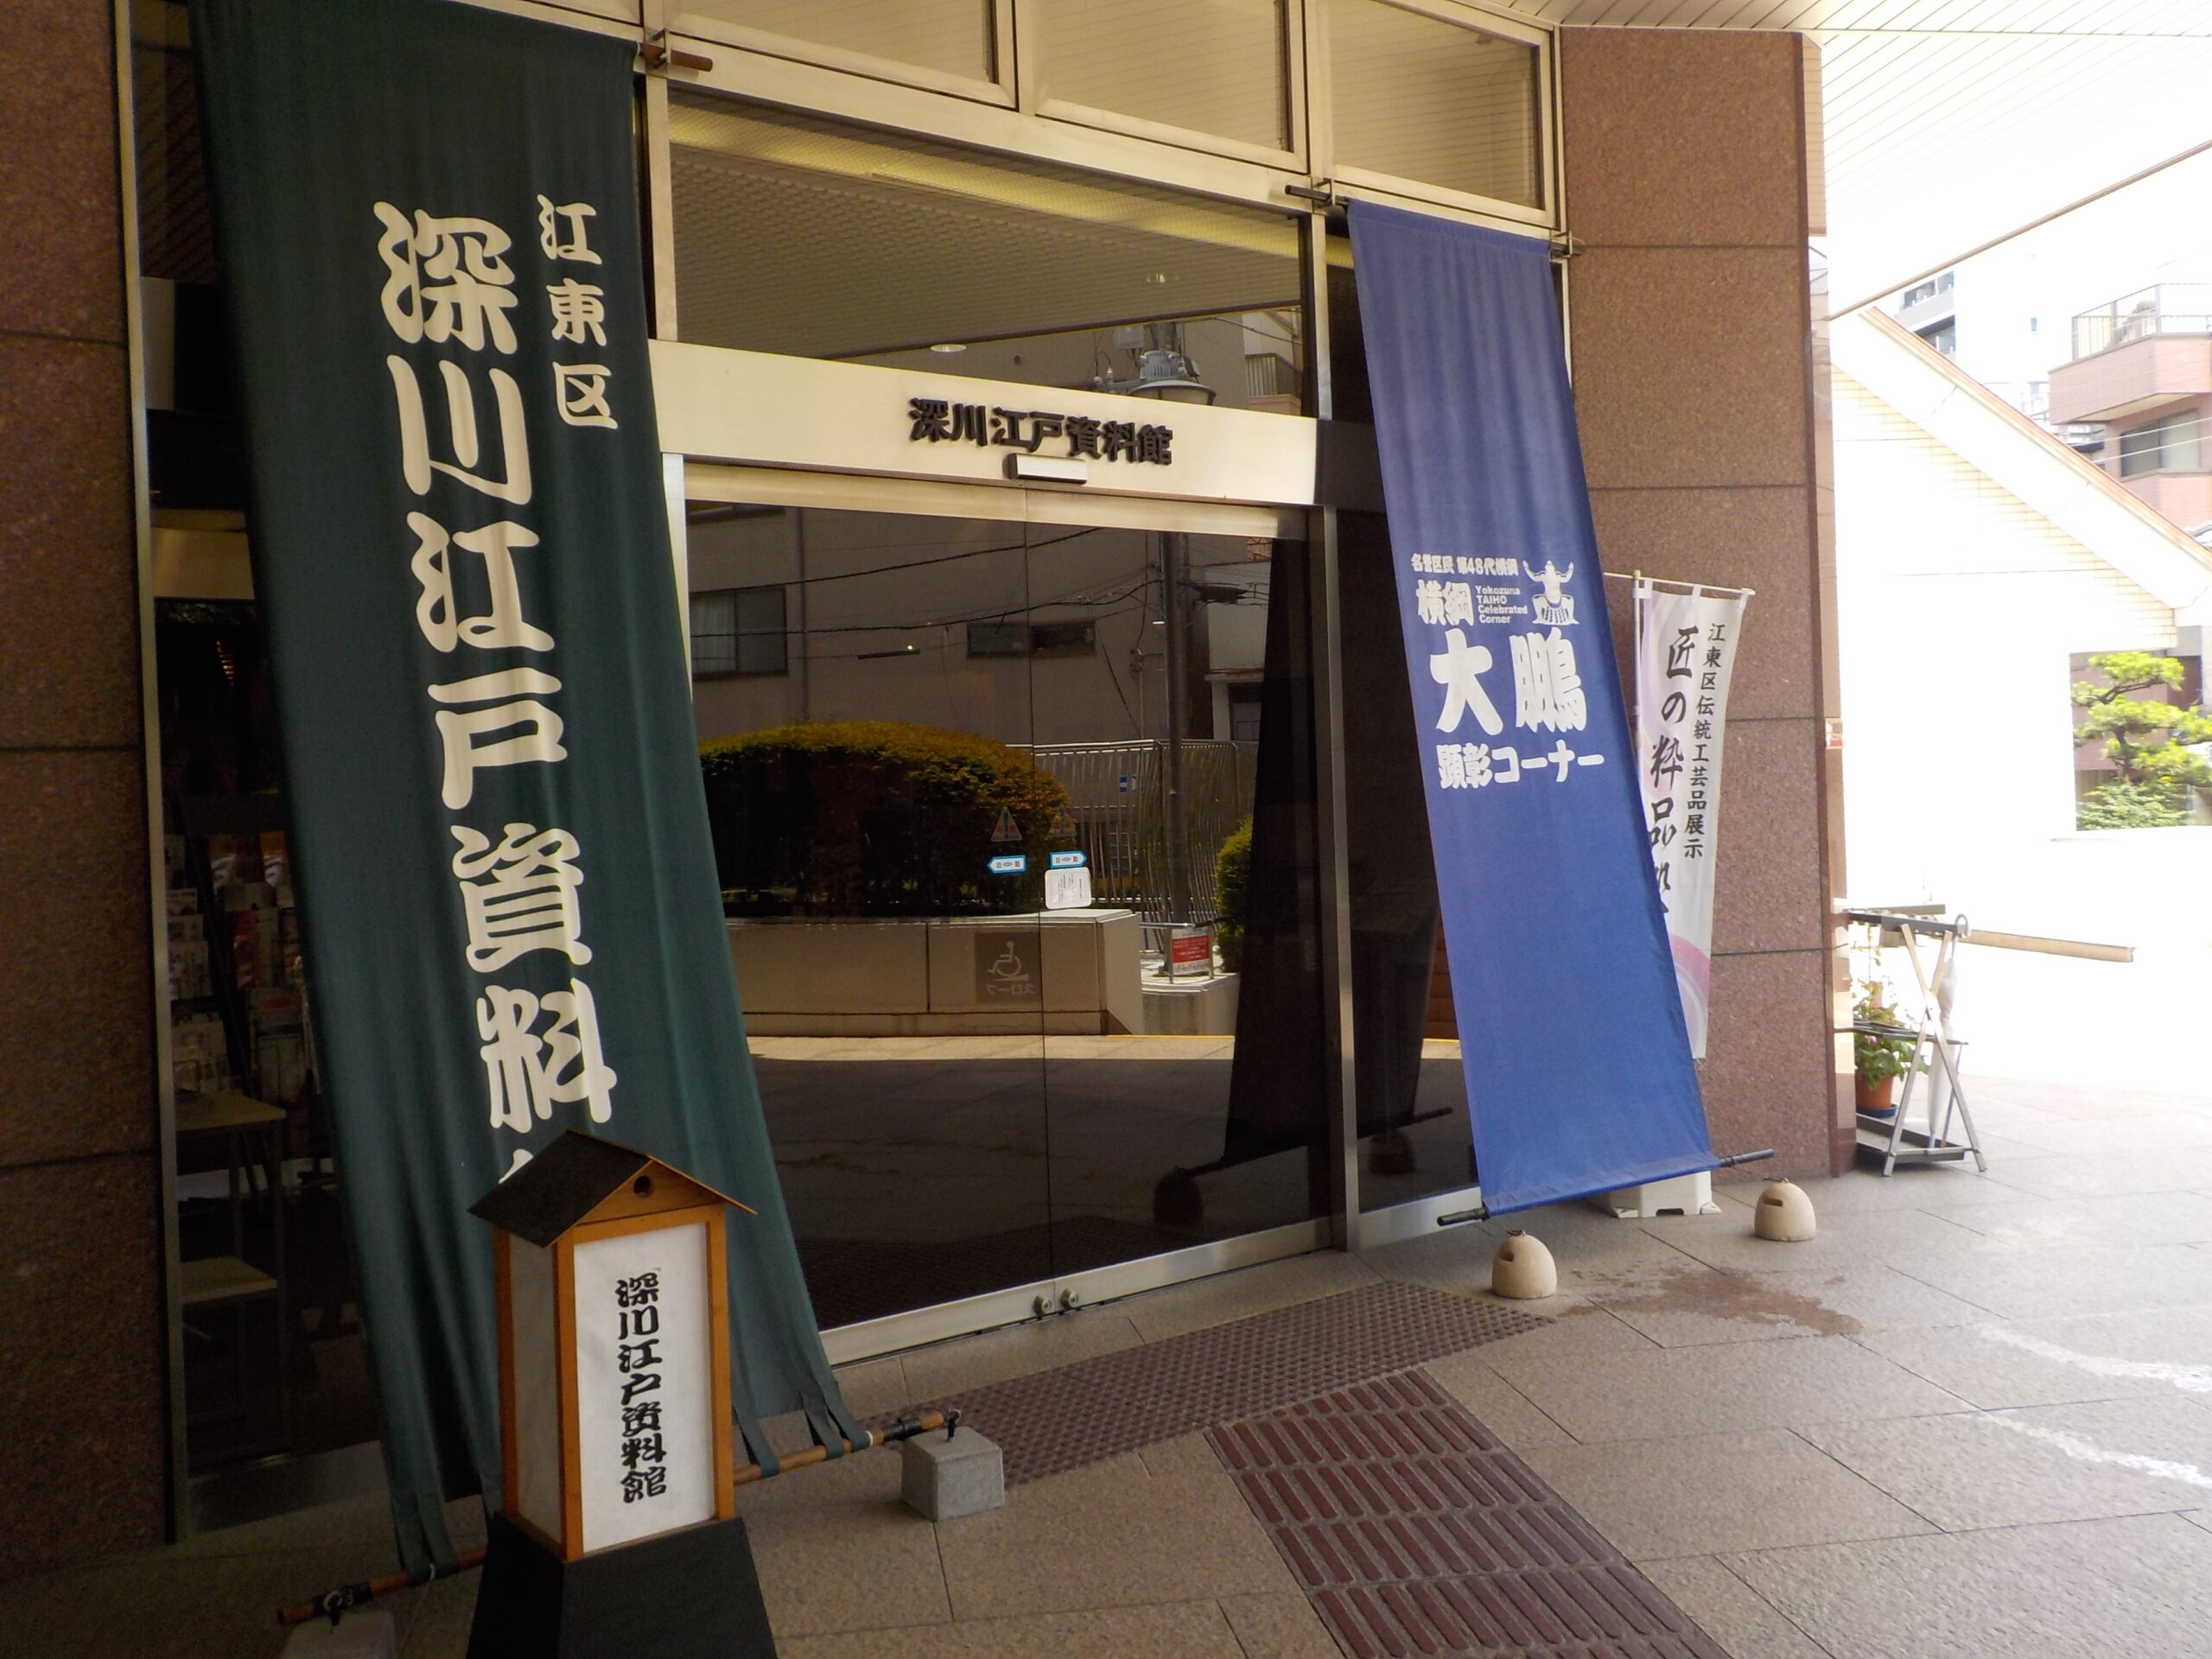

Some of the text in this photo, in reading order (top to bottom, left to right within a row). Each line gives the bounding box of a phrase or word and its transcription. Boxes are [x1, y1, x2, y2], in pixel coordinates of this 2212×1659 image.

[537, 194, 619, 429] 江東区
[908, 397, 1173, 465] 深川江戸資料館
[1415, 579, 1474, 626] 横綱
[1475, 585, 1521, 595] Yokozuna
[1476, 595, 1507, 605] TAIHO
[1478, 604, 1529, 614] Celebrated
[1479, 614, 1511, 624] Corner
[373, 200, 617, 1184] 深川江戸資料
[1429, 626, 1587, 735] 大鵬
[1436, 739, 1605, 789] 顕彰コーナー
[1683, 622, 1726, 858] 江東区伝統工芸品展示
[614, 1272, 667, 1503] 深川江戸資料館
